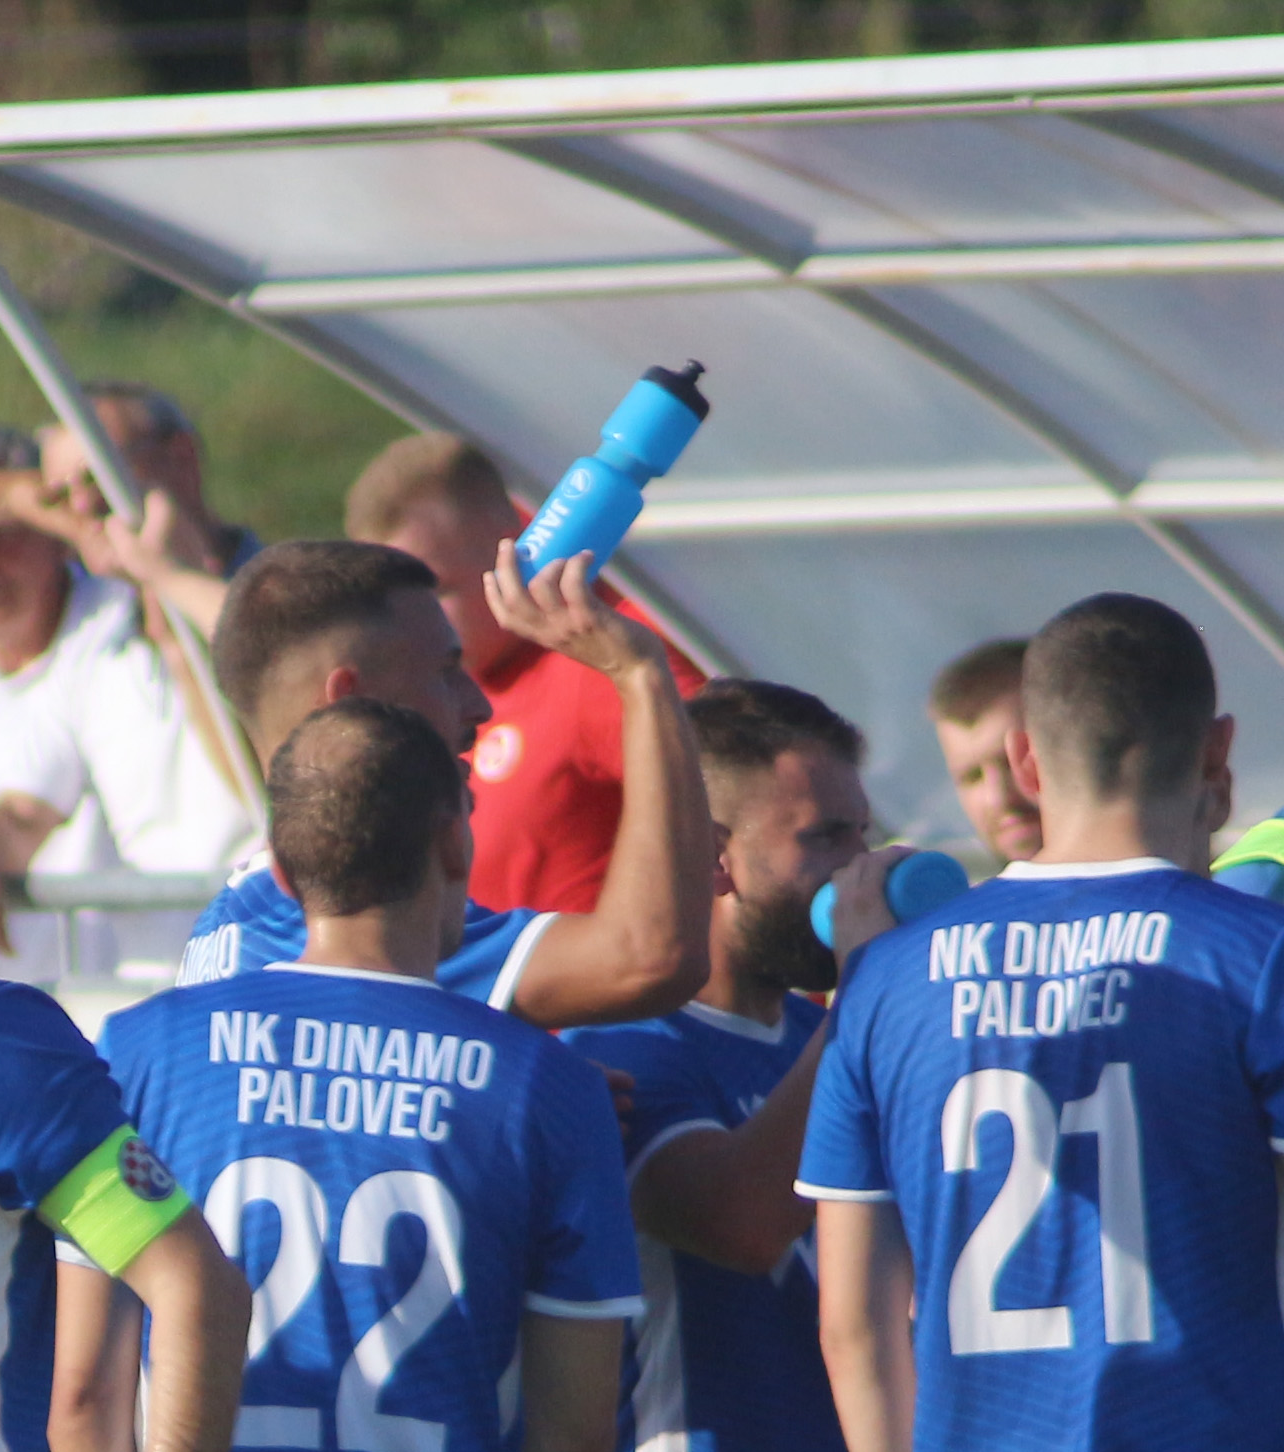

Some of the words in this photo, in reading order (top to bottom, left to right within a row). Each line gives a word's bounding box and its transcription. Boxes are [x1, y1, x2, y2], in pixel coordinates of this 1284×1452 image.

[929, 922, 994, 982] NK
[1003, 911, 1171, 976] DINAMO
[952, 968, 1131, 1038] PALOVEC
[209, 1010, 279, 1064] NK
[292, 1017, 494, 1090] DINAMO
[237, 1067, 454, 1142] PALOVEC
[941, 1061, 1153, 1357] 21
